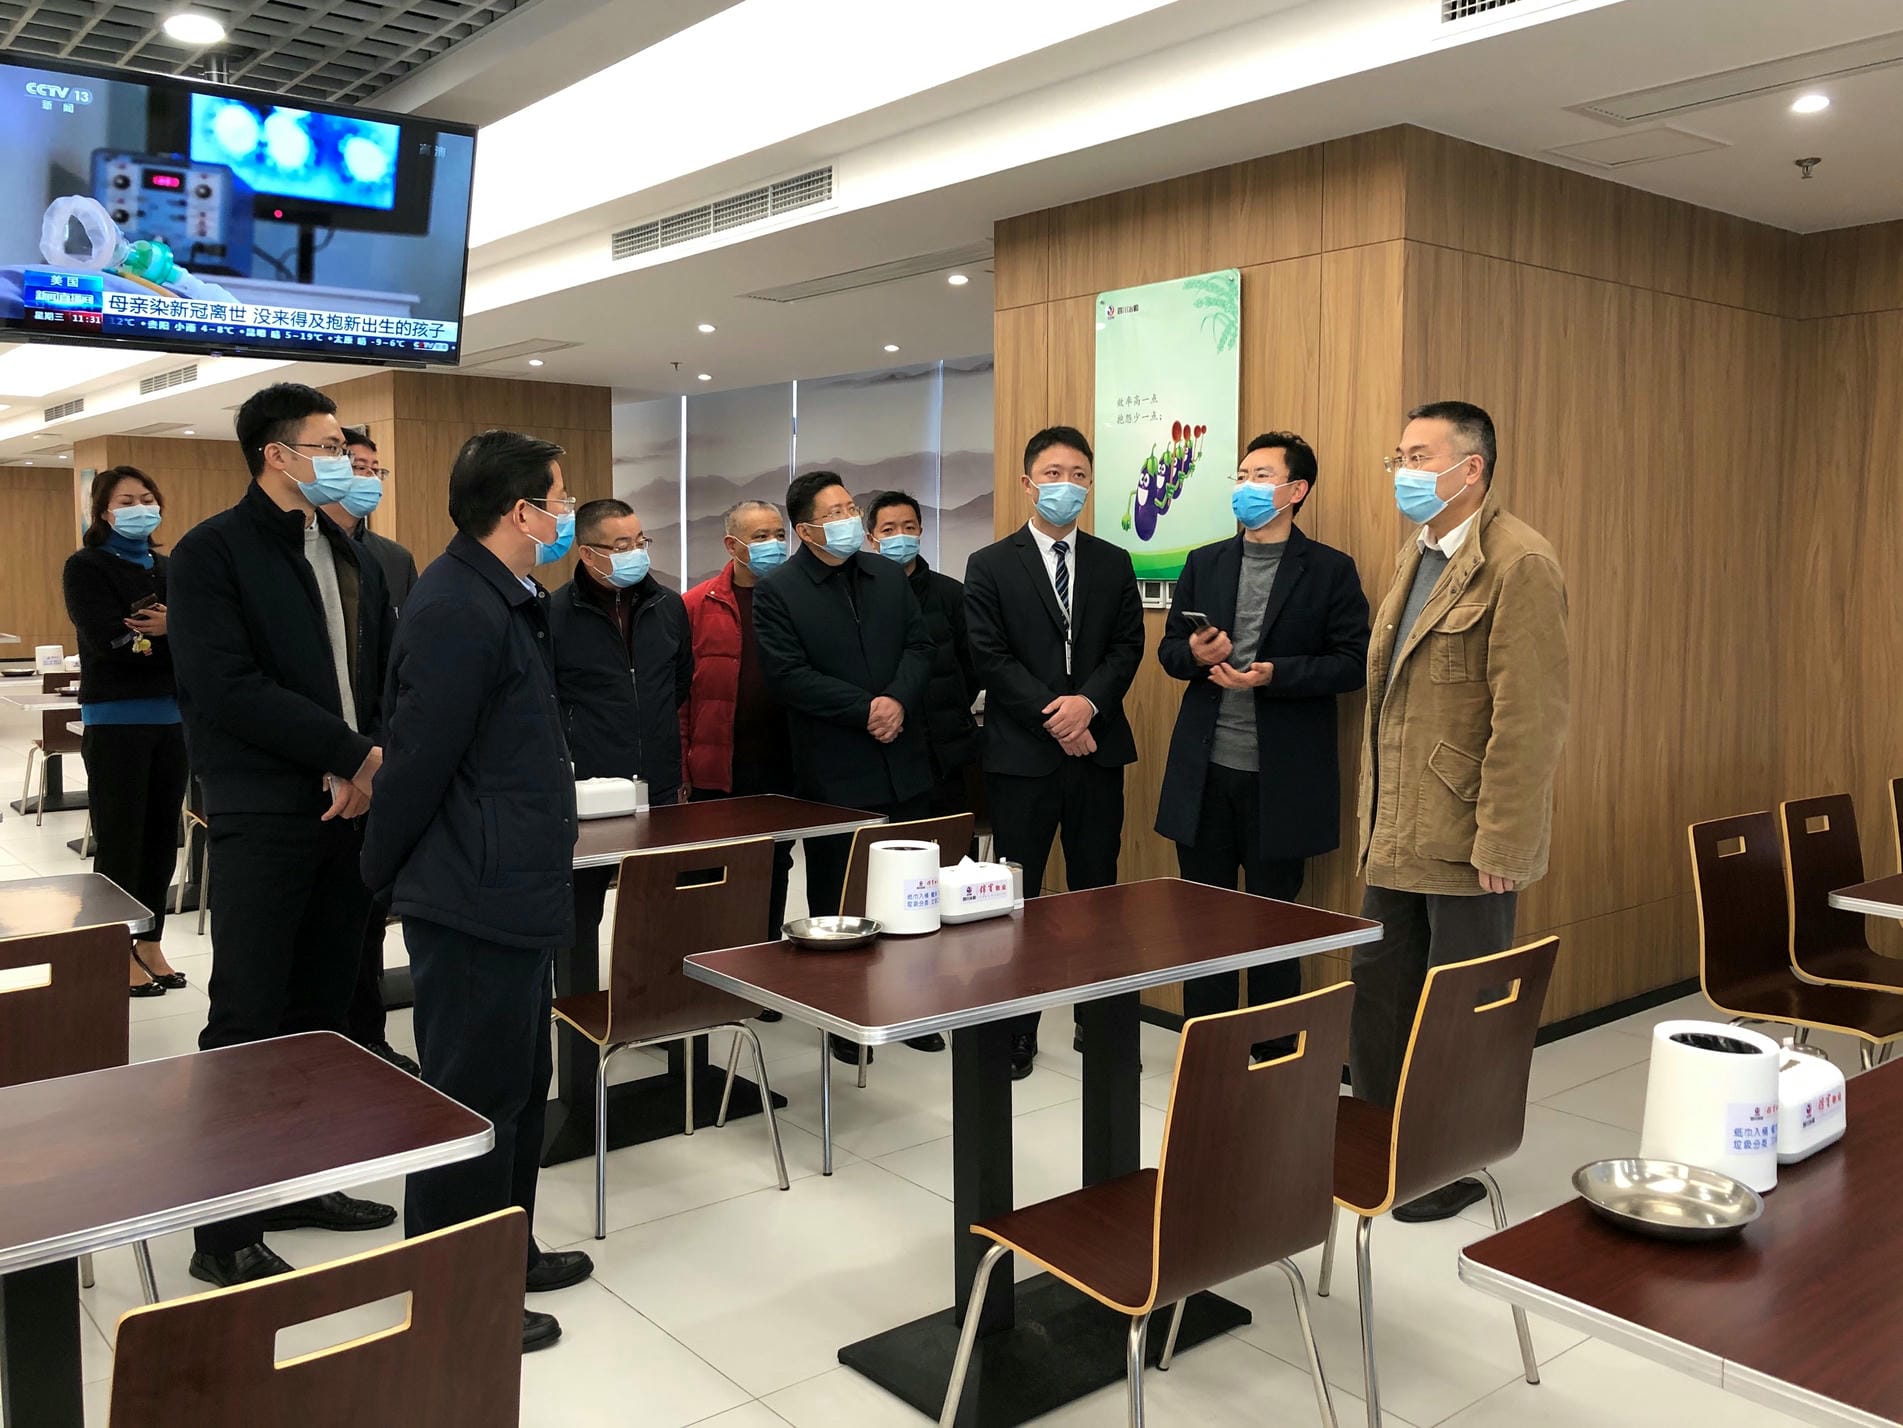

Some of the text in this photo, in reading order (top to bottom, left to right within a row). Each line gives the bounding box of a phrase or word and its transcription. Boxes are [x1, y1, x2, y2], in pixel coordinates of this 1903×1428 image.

[26, 82, 89, 102] CCTV 13
[51, 275, 79, 288] 美国
[34, 311, 101, 324] 星期三 11:31
[108, 294, 446, 339] 母亲染新冠离世 没来得及抱新出生的孩子
